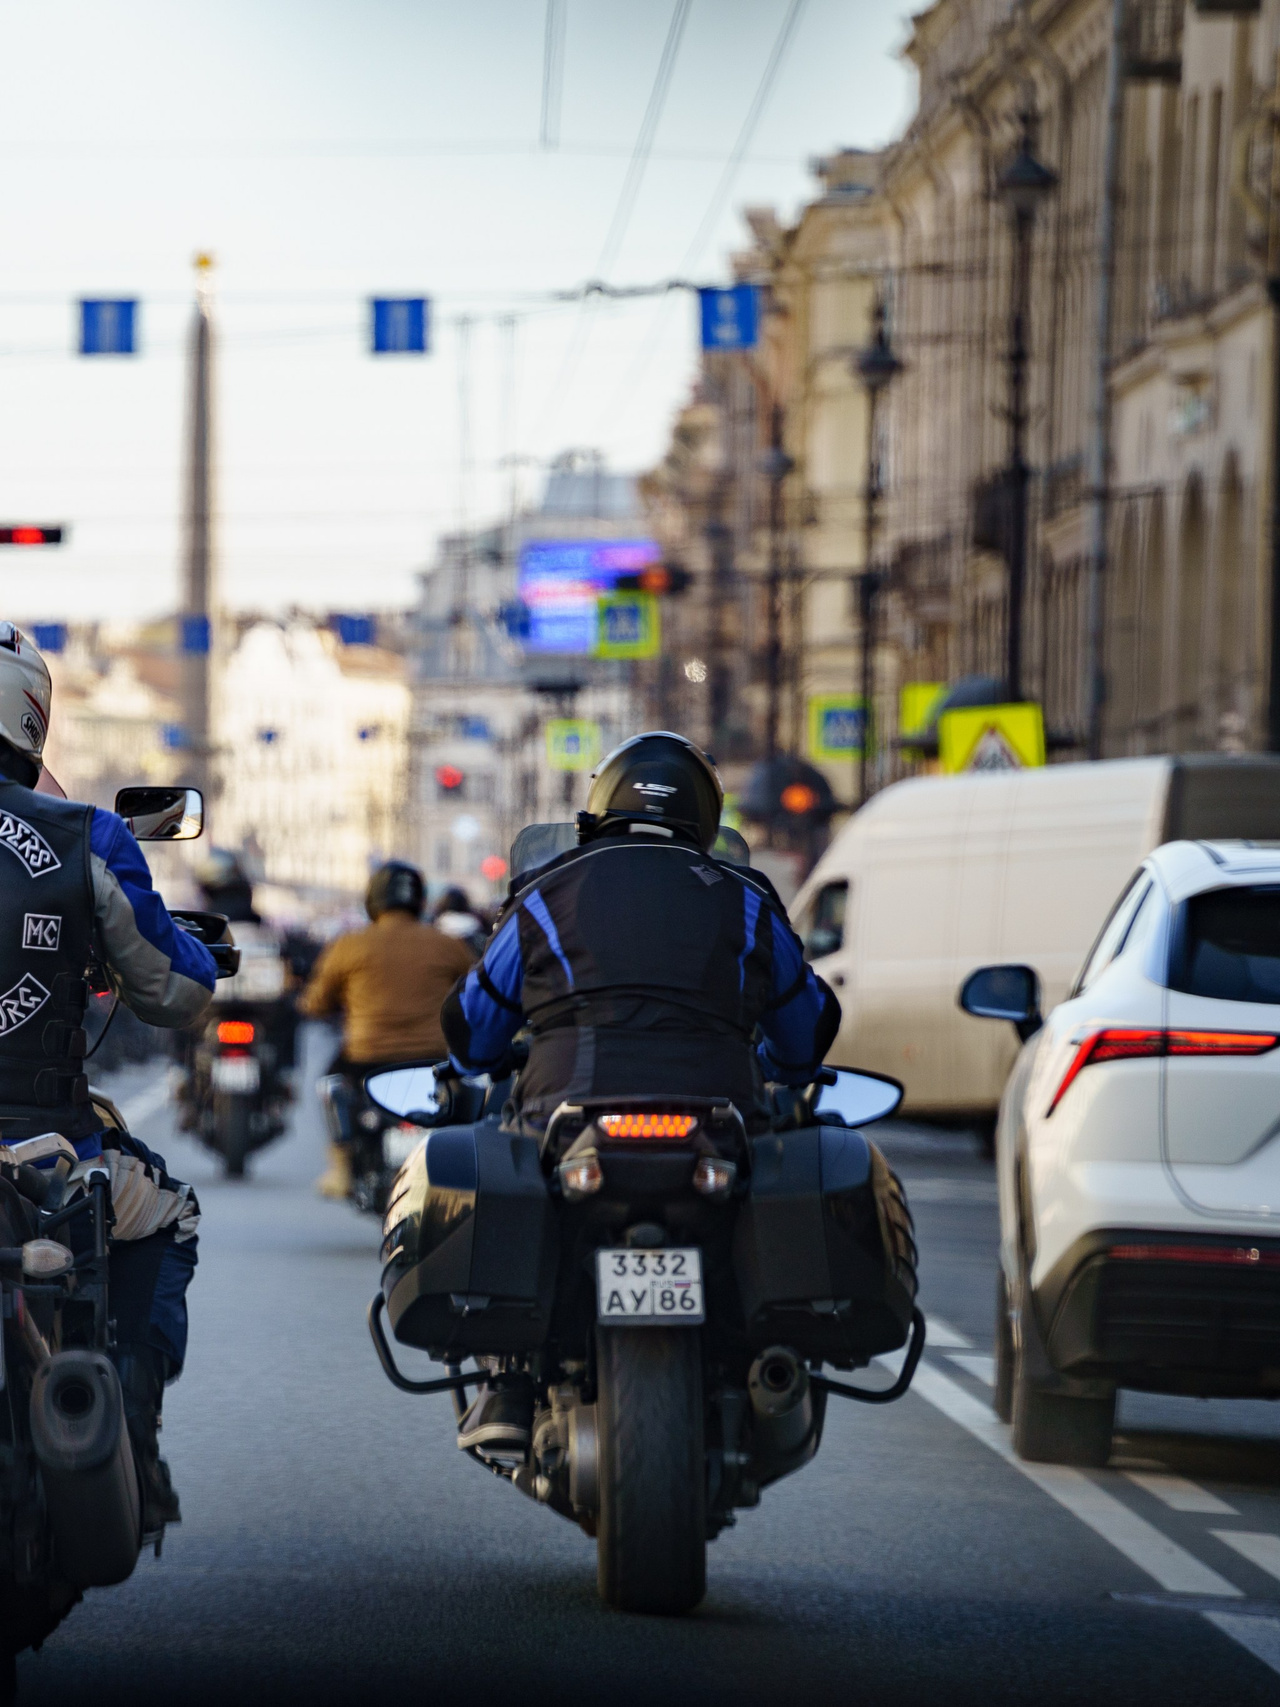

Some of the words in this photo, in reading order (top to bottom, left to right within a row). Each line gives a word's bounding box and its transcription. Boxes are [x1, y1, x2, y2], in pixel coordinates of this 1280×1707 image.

[26, 917, 57, 947] MC
[611, 1253, 687, 1277] 3332
[660, 1289, 696, 1311] 86
